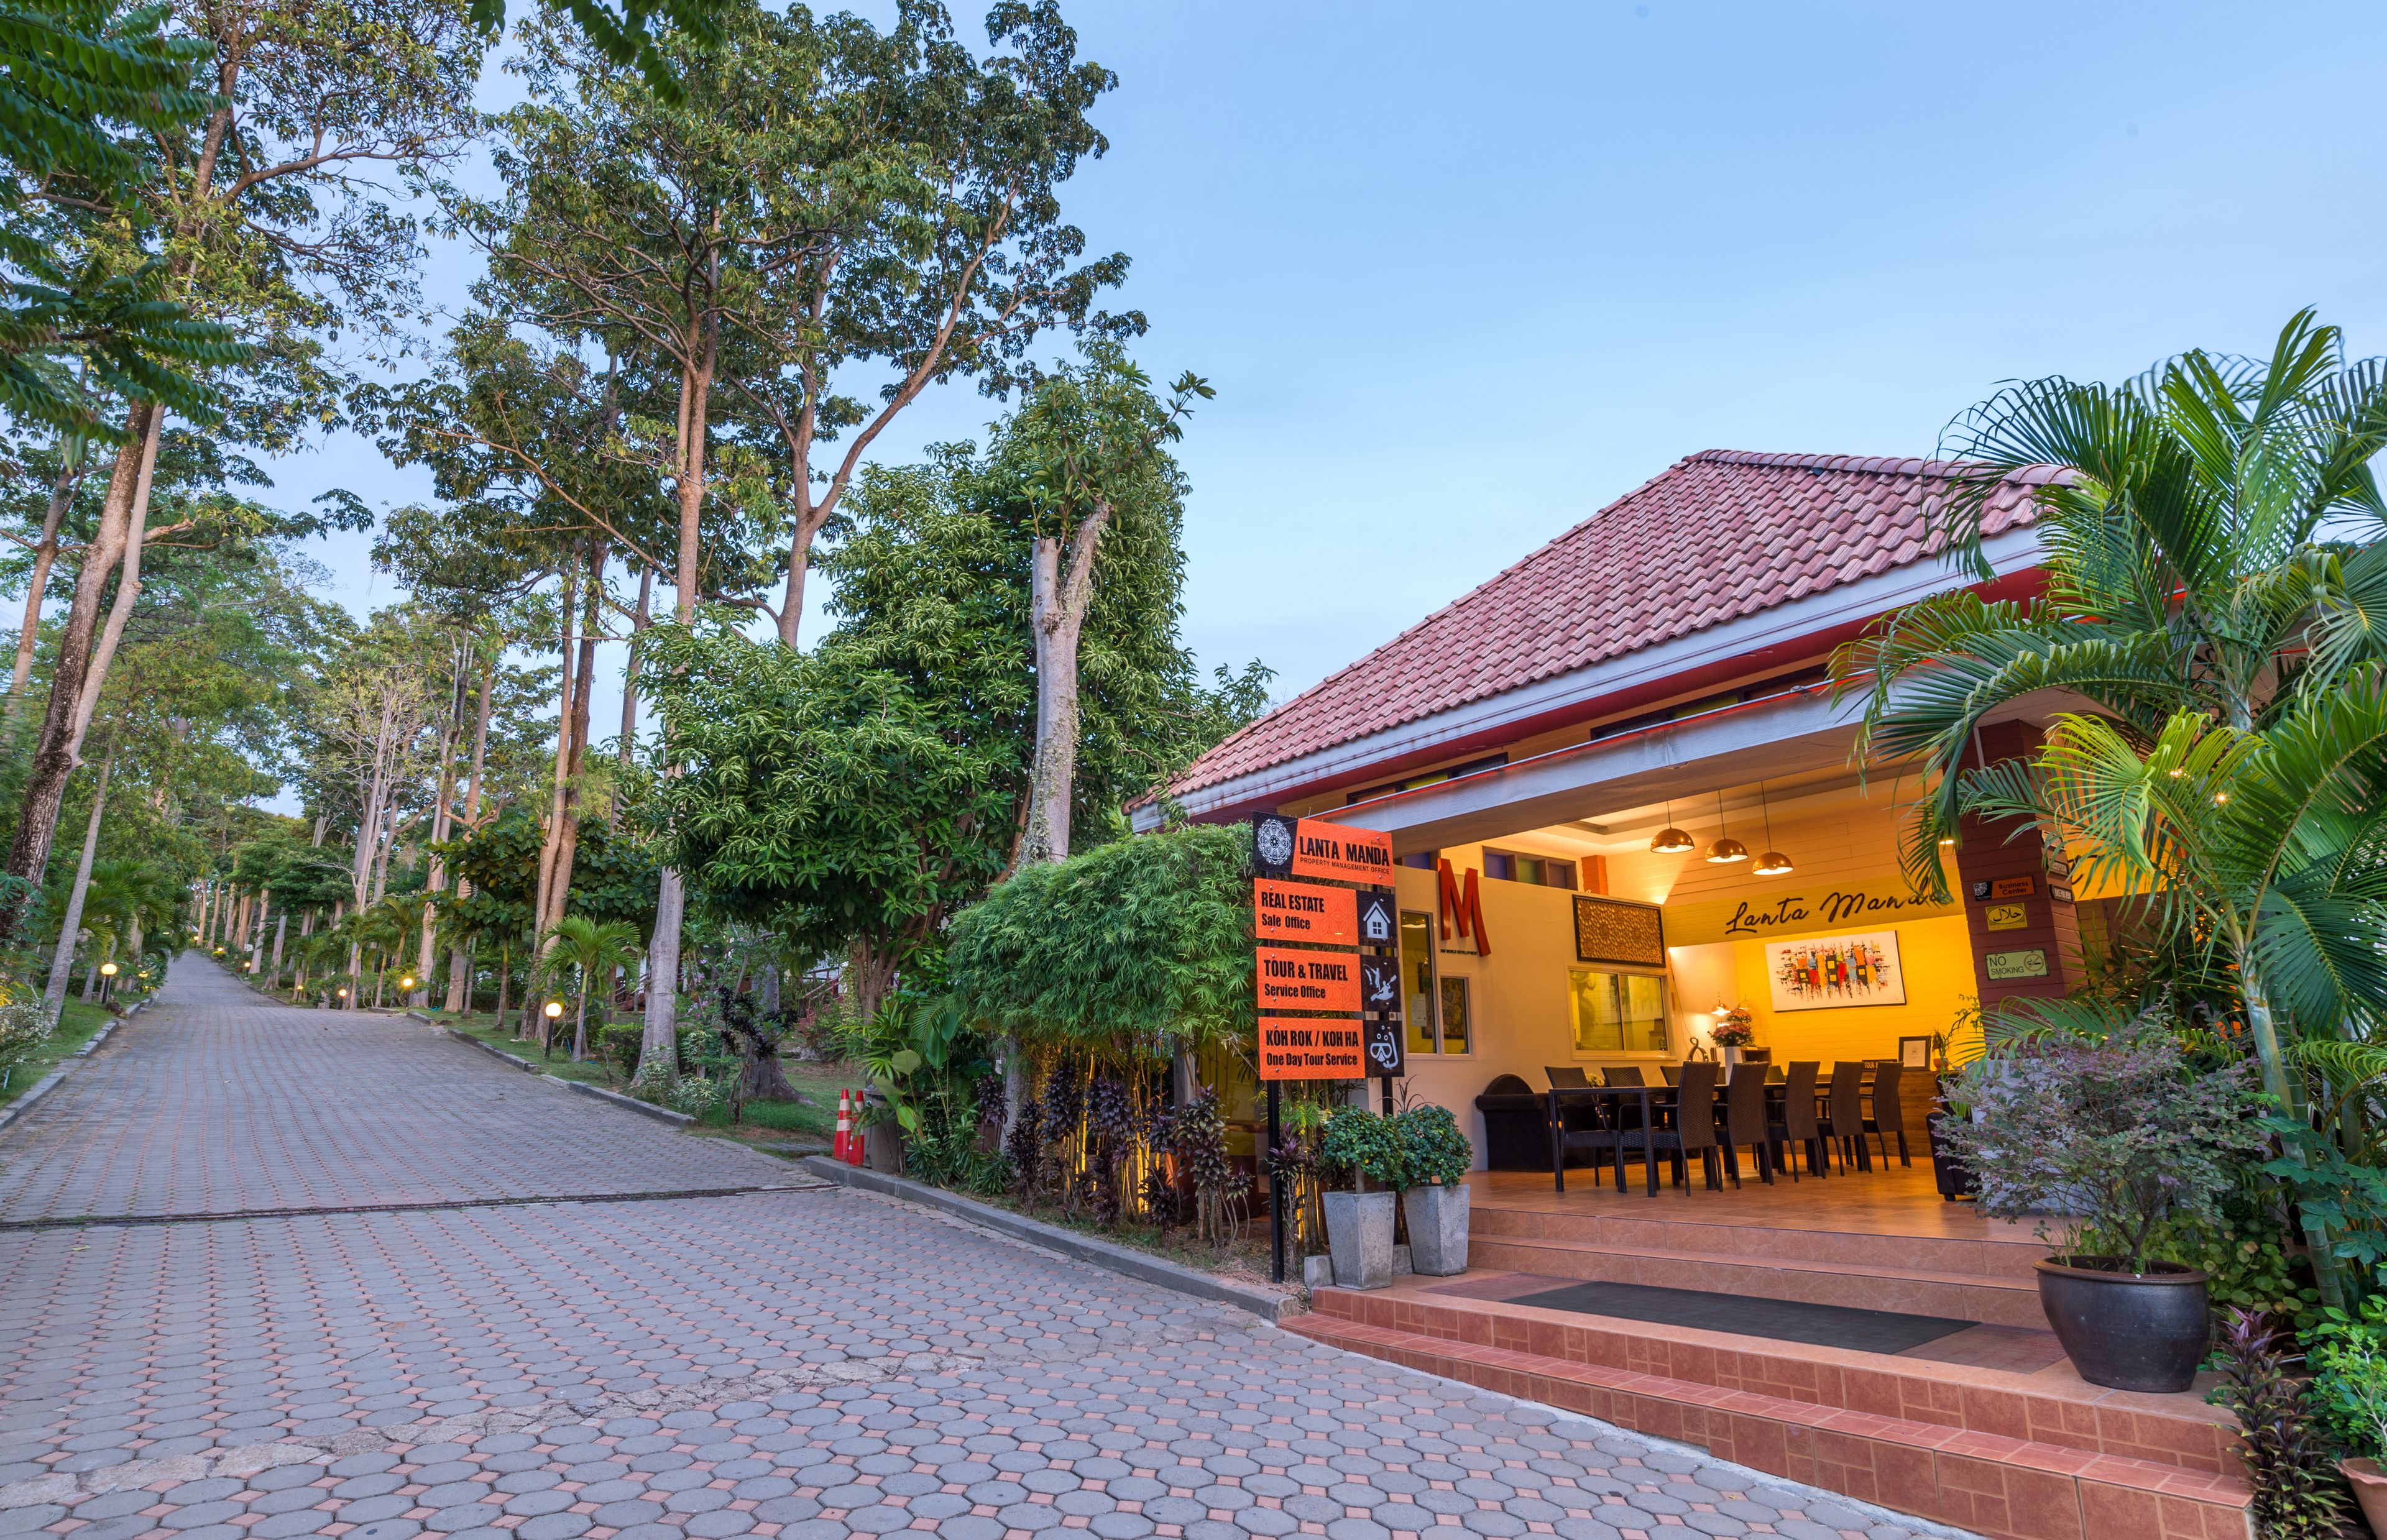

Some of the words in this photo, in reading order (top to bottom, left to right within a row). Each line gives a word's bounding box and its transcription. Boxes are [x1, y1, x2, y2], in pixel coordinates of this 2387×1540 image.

[1300, 836, 1340, 859] LANTA
[1346, 843, 1390, 866] MANDA
[1300, 857, 1330, 866] PROPERTY
[1331, 861, 1370, 871] MANAGEMENT
[1371, 866, 1390, 874] OFFICE
[1998, 881, 2029, 889] Business
[2002, 887, 2027, 896] Center
[1261, 891, 1287, 909] REAL
[1289, 895, 1325, 913] ESTATE
[1262, 914, 1281, 927] Sale
[1285, 916, 1310, 930] Office
[1725, 897, 1810, 935] Lanta
[1993, 907, 2021, 922] حلال
[1989, 956, 2007, 967] NO
[1264, 959, 1295, 978] TOUR
[1298, 965, 1307, 979] &
[1308, 963, 1348, 981] TRAVEL
[1991, 966, 2025, 976] SMOKING
[1264, 983, 1299, 997] Service
[1300, 985, 1326, 999] Office
[1266, 1030, 1288, 1047] KOH
[1290, 1030, 1313, 1047] ROK
[1315, 1030, 1320, 1047] /
[1322, 1031, 1343, 1047] KOH
[1345, 1032, 1359, 1047] HA
[1266, 1053, 1284, 1066] One
[1286, 1053, 1302, 1067] Day
[1304, 1053, 1325, 1066] Tour
[1325, 1053, 1358, 1066] Service
